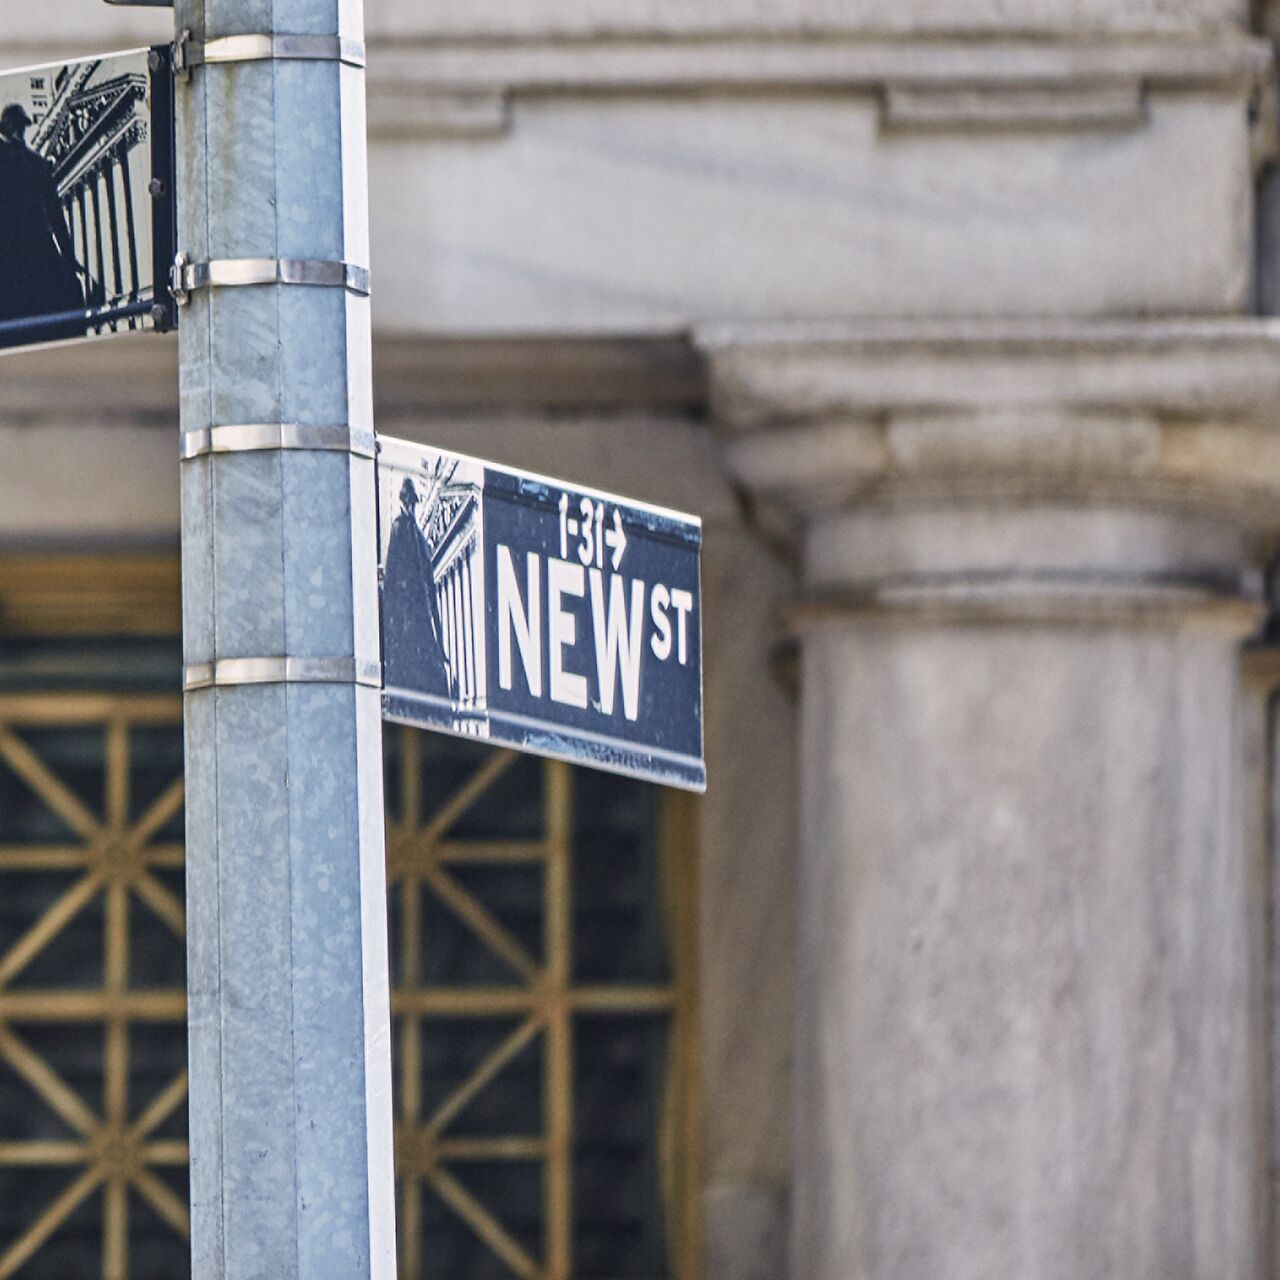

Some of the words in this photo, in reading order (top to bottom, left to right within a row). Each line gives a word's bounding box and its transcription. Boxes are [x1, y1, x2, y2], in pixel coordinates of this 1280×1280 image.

[558, 492, 604, 569] 1-31
[496, 543, 644, 721] NEW
[650, 583, 693, 665] ST
